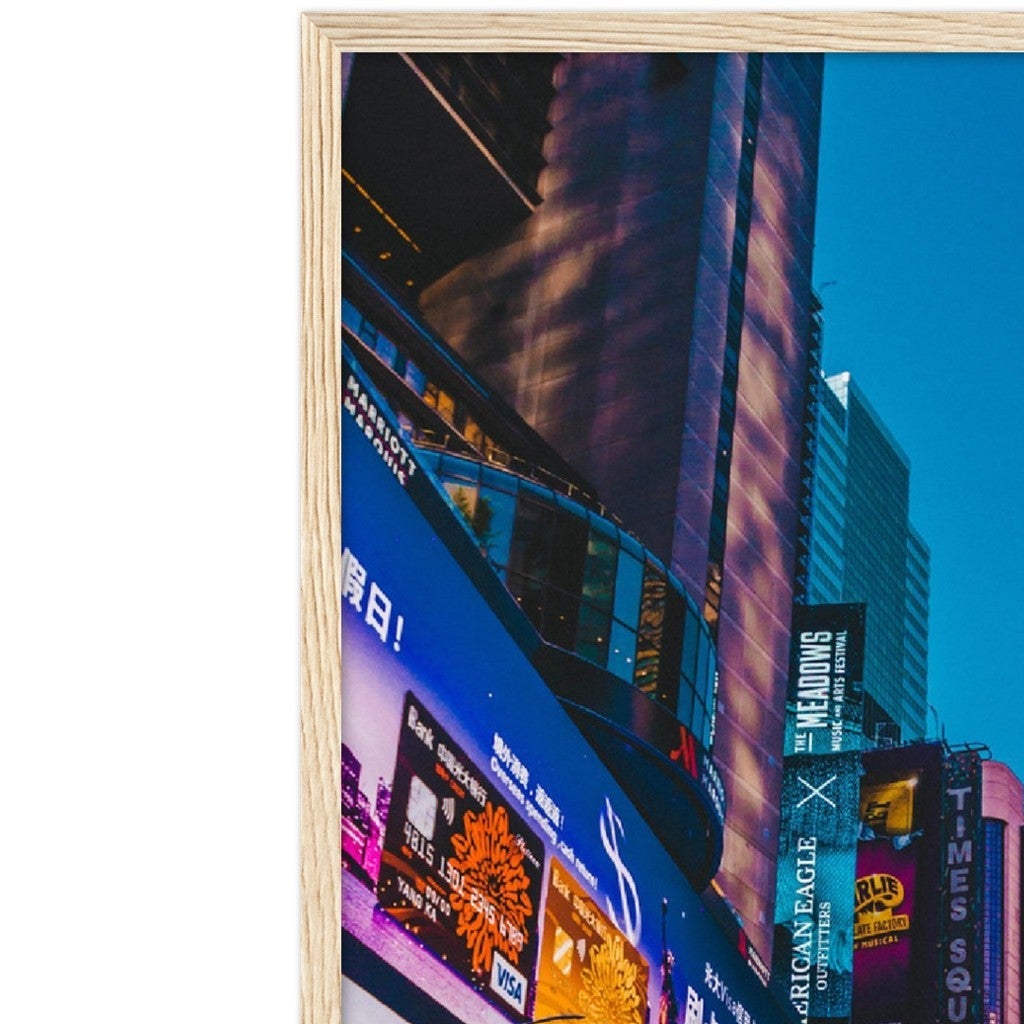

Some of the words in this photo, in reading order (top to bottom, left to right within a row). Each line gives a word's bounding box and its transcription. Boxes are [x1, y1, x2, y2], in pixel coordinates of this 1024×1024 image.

[347, 375, 416, 475] MARRIOTT
[834, 630, 847, 674] FESTIVAL
[796, 631, 833, 729] MEADOWS
[833, 677, 845, 702] ARTS
[795, 732, 807, 753] THE
[832, 719, 843, 752] MUSIC
[794, 837, 817, 915] EAGLE
[946, 787, 972, 922] TIMES
[856, 876, 898, 903] RLIE
[816, 901, 831, 991] OUTFITTERS
[861, 936, 899, 948] MUSICAL
[497, 962, 523, 1007] VISA
